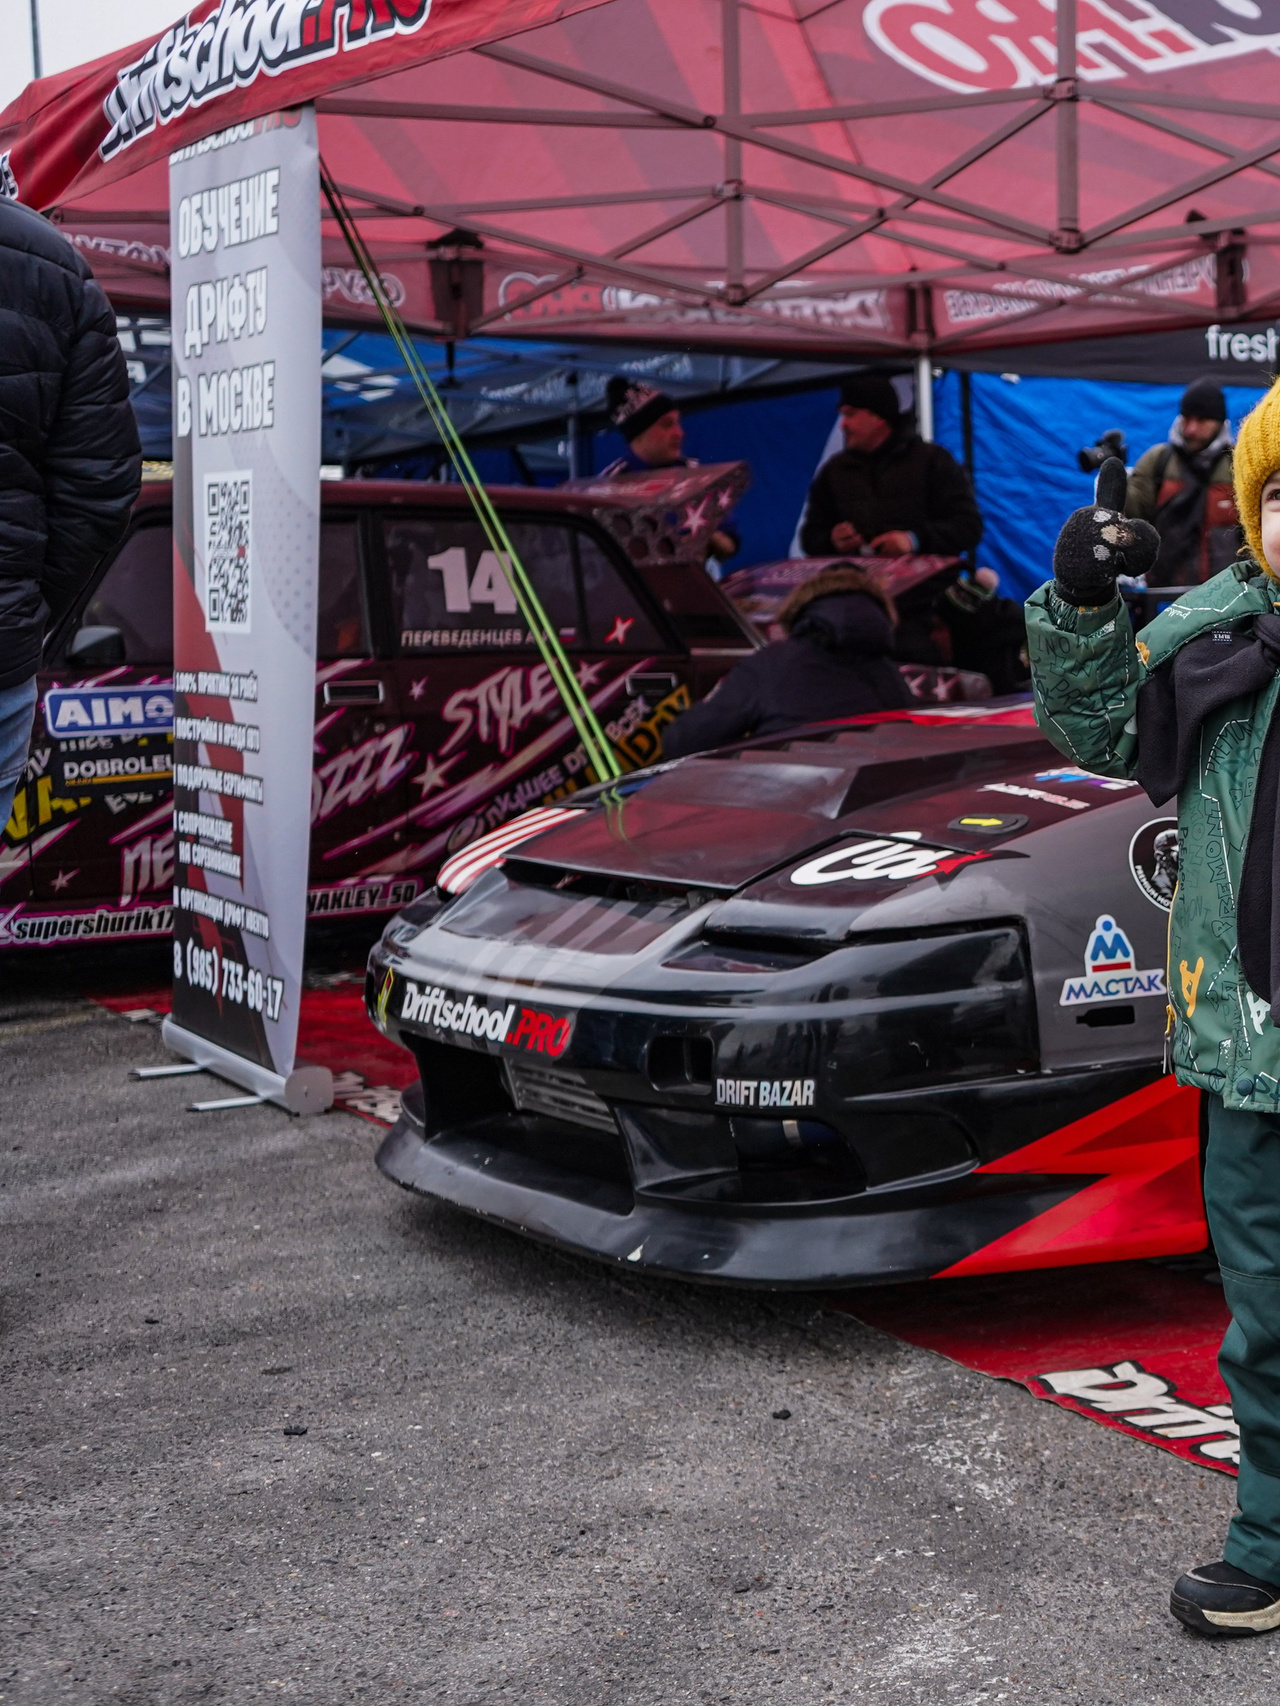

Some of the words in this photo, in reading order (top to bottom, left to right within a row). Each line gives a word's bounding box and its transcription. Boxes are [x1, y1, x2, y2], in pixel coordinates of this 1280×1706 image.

[177, 166, 281, 260] ОБУЧЕНИЕ
[183, 265, 269, 359] ДРИФТУ
[176, 374, 192, 438] В
[198, 360, 276, 439] МОСКВЕ
[428, 547, 518, 614] 14
[173, 939, 183, 979] 8
[186, 936, 219, 996] (985)
[221, 958, 285, 1022] 733-60-17
[401, 981, 570, 1057] Driftschool.PRO
[716, 1078, 757, 1106] DRIFT
[758, 1078, 814, 1107] BAZAR
